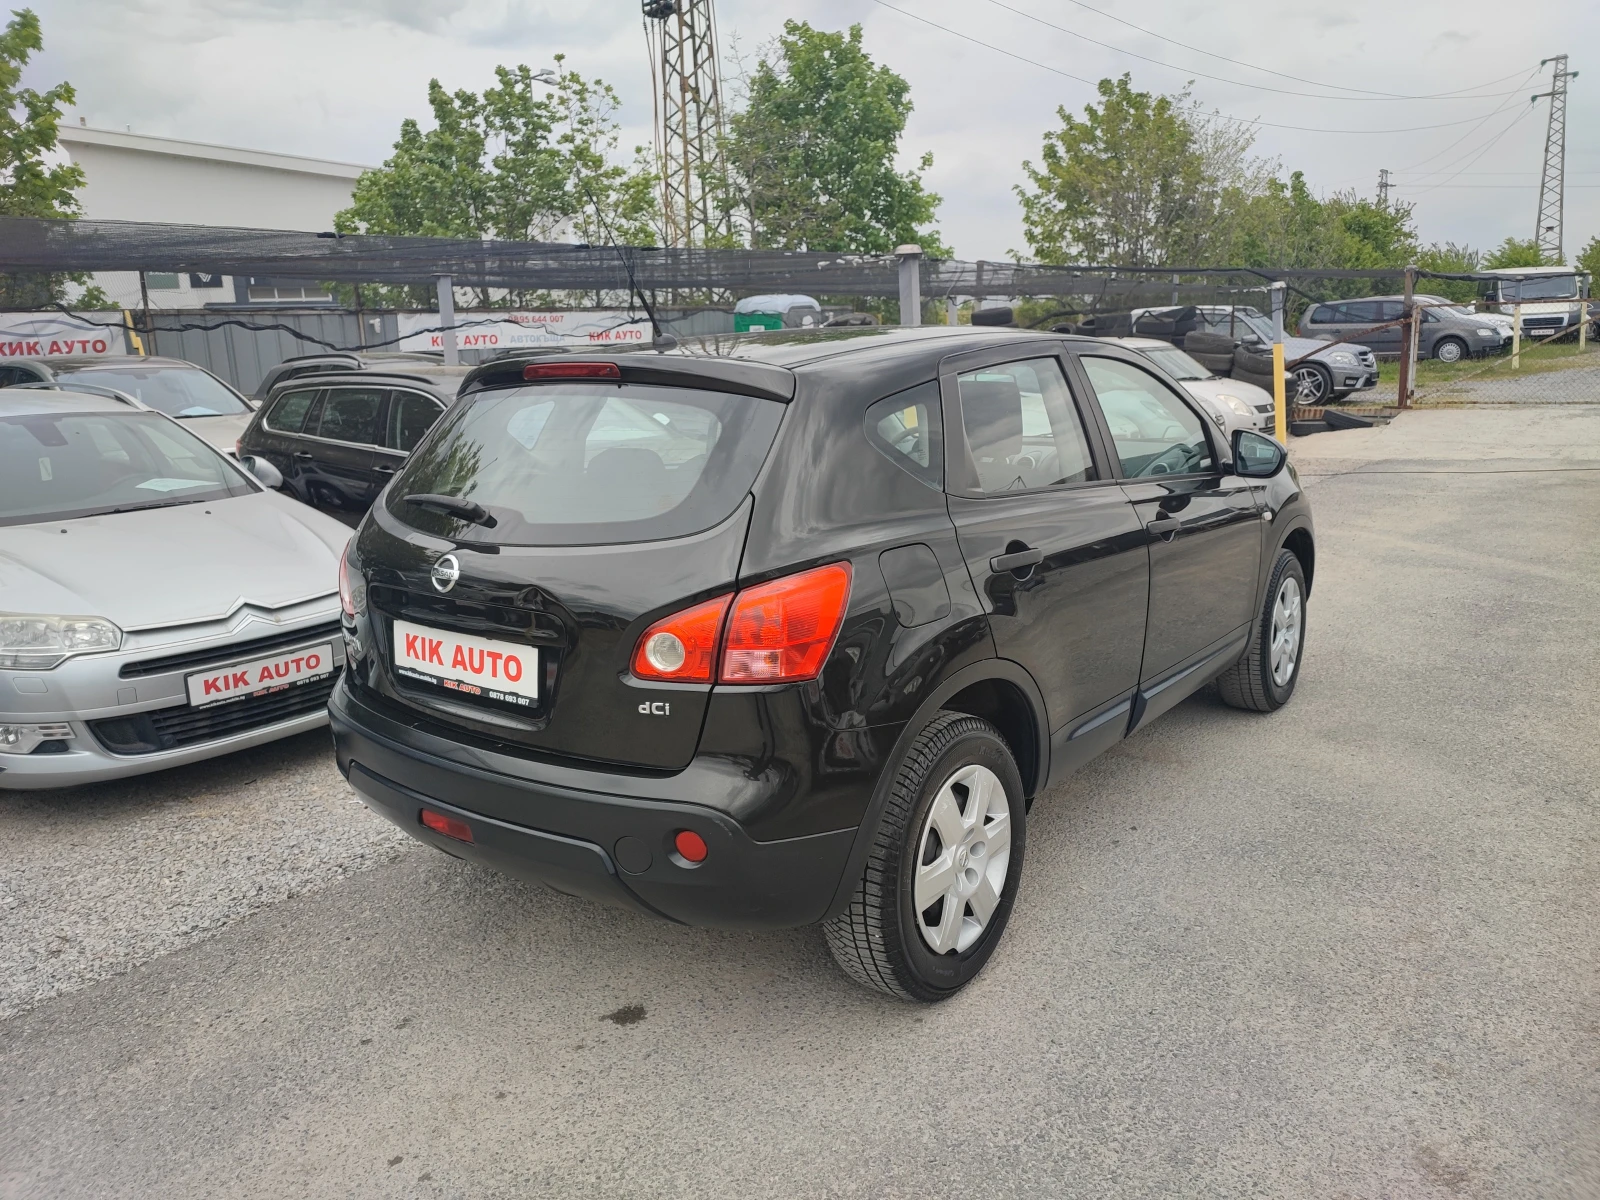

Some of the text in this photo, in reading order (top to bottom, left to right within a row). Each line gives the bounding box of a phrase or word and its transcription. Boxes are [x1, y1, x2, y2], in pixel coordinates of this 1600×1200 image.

[532, 315, 547, 323] 644
[550, 315, 565, 323] 007
[463, 334, 499, 346] АУТО
[510, 334, 566, 345] АВТОКЪЩА
[590, 330, 643, 342] КИК АУТО
[48, 339, 107, 355] АУТО
[405, 632, 444, 666] KIK
[451, 644, 523, 683] AUTO
[203, 654, 321, 695] KIK AUTO
[268, 683, 290, 693] AUTO
[443, 679, 458, 690] KIK
[459, 684, 481, 695] AUTO
[489, 691, 504, 701] 0878
[505, 694, 517, 703] 693
[517, 697, 530, 706] 007
[638, 701, 670, 716] dCi
